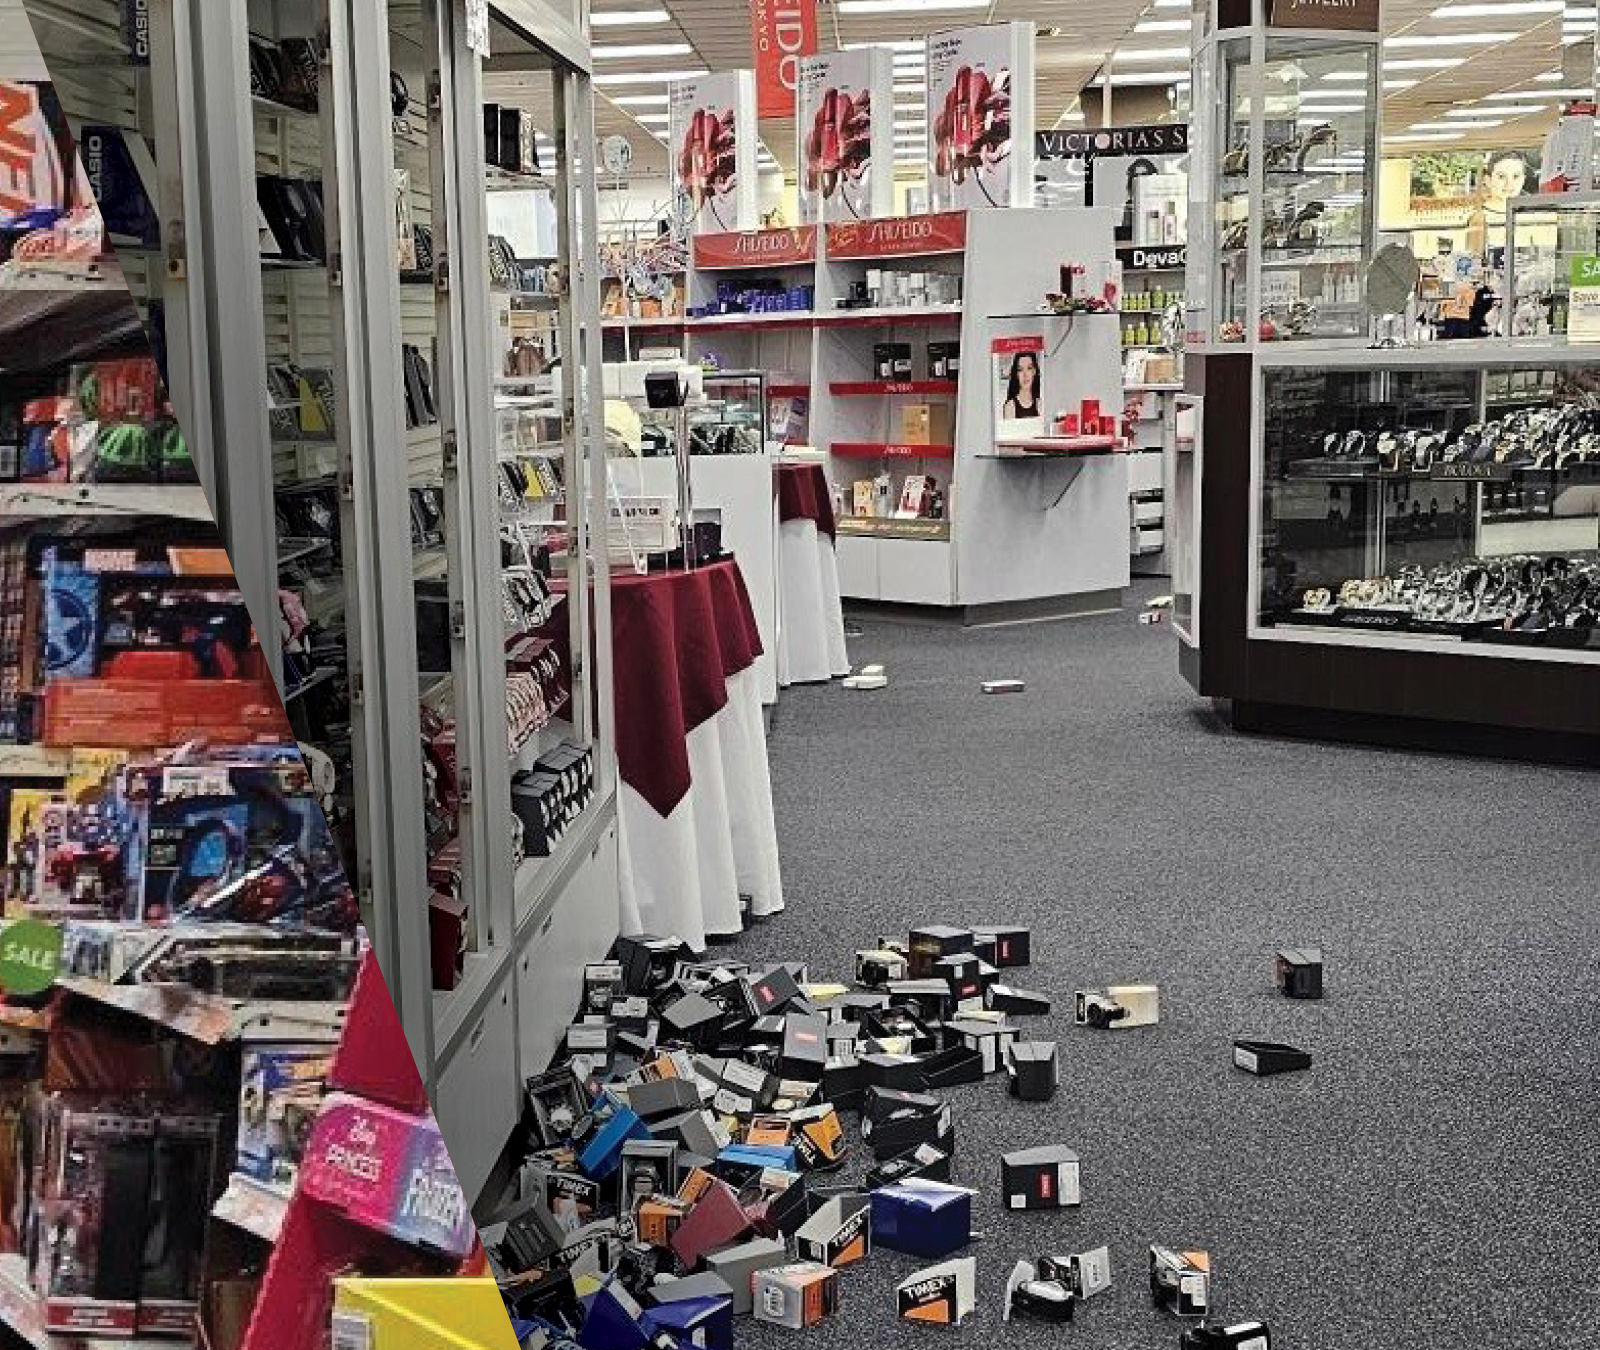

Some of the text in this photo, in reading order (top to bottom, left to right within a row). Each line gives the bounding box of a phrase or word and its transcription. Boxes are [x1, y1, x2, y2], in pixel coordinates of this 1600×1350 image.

[1041, 130, 1164, 152] VICTORIA'S
[89, 135, 102, 203] CASIO
[733, 234, 790, 253] SHISEIDO
[867, 221, 933, 244] SHISEIDO
[4, 942, 54, 970] SALE
[556, 1176, 594, 1196] TIMEX
[833, 1213, 864, 1247] TIMEX
[554, 1232, 608, 1264] TIMEX
[903, 1275, 948, 1300] TIMEX
